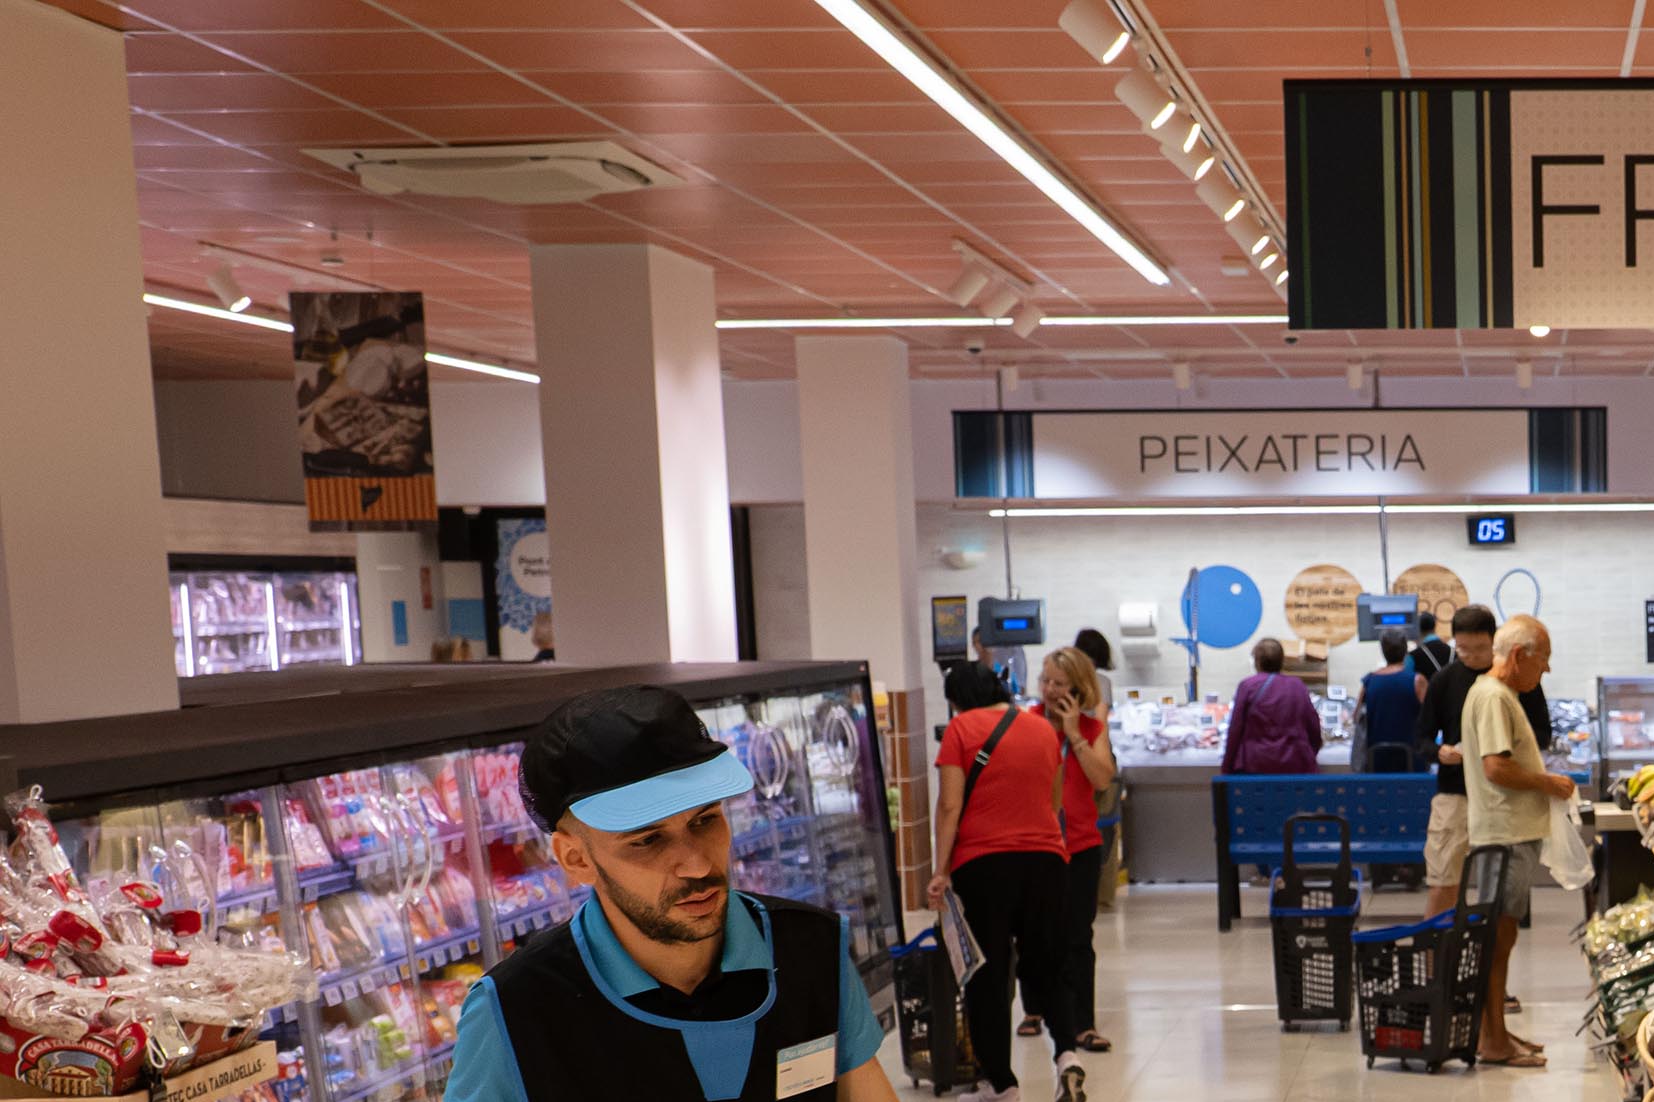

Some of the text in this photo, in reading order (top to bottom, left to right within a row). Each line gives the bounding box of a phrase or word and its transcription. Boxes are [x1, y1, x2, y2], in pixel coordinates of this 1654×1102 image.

[1139, 433, 1426, 473] PEIXATERIA
[1477, 518, 1505, 542] 05
[185, 1080, 209, 1102] CASA
[208, 1058, 262, 1094] TARRADELLAS
